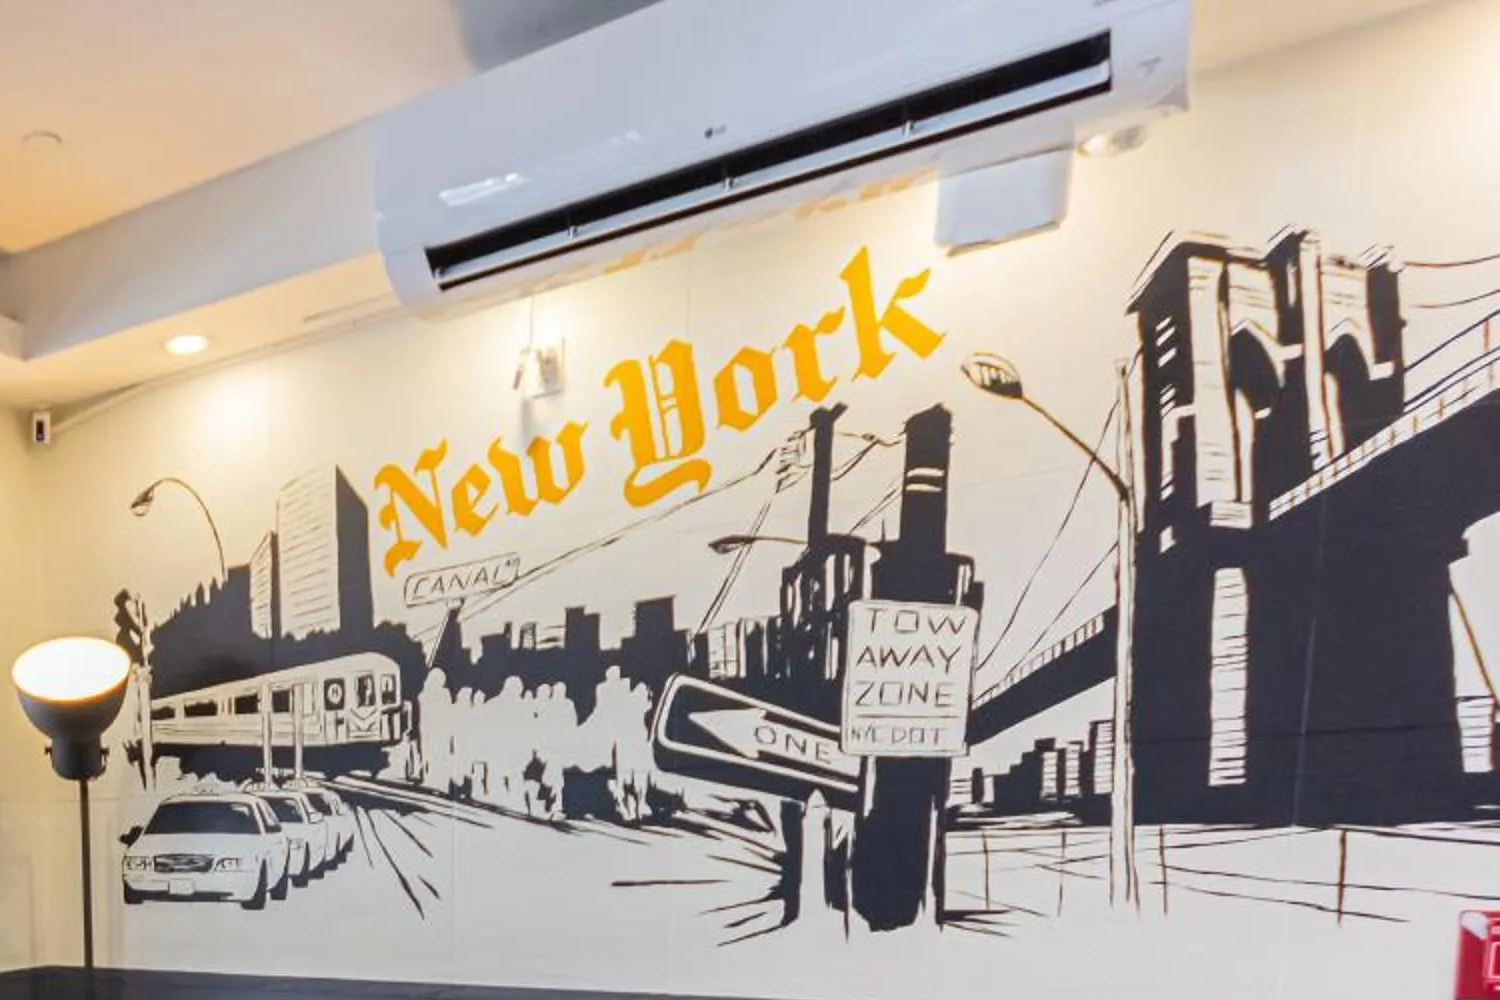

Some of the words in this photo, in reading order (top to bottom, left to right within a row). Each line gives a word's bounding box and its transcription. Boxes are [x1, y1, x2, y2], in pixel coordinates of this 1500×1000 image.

[374, 421, 589, 577] New
[603, 246, 948, 509] York
[866, 607, 967, 636] TOW
[854, 644, 962, 674] AWAY
[854, 681, 958, 708] ZONE
[754, 724, 833, 765] ONE
